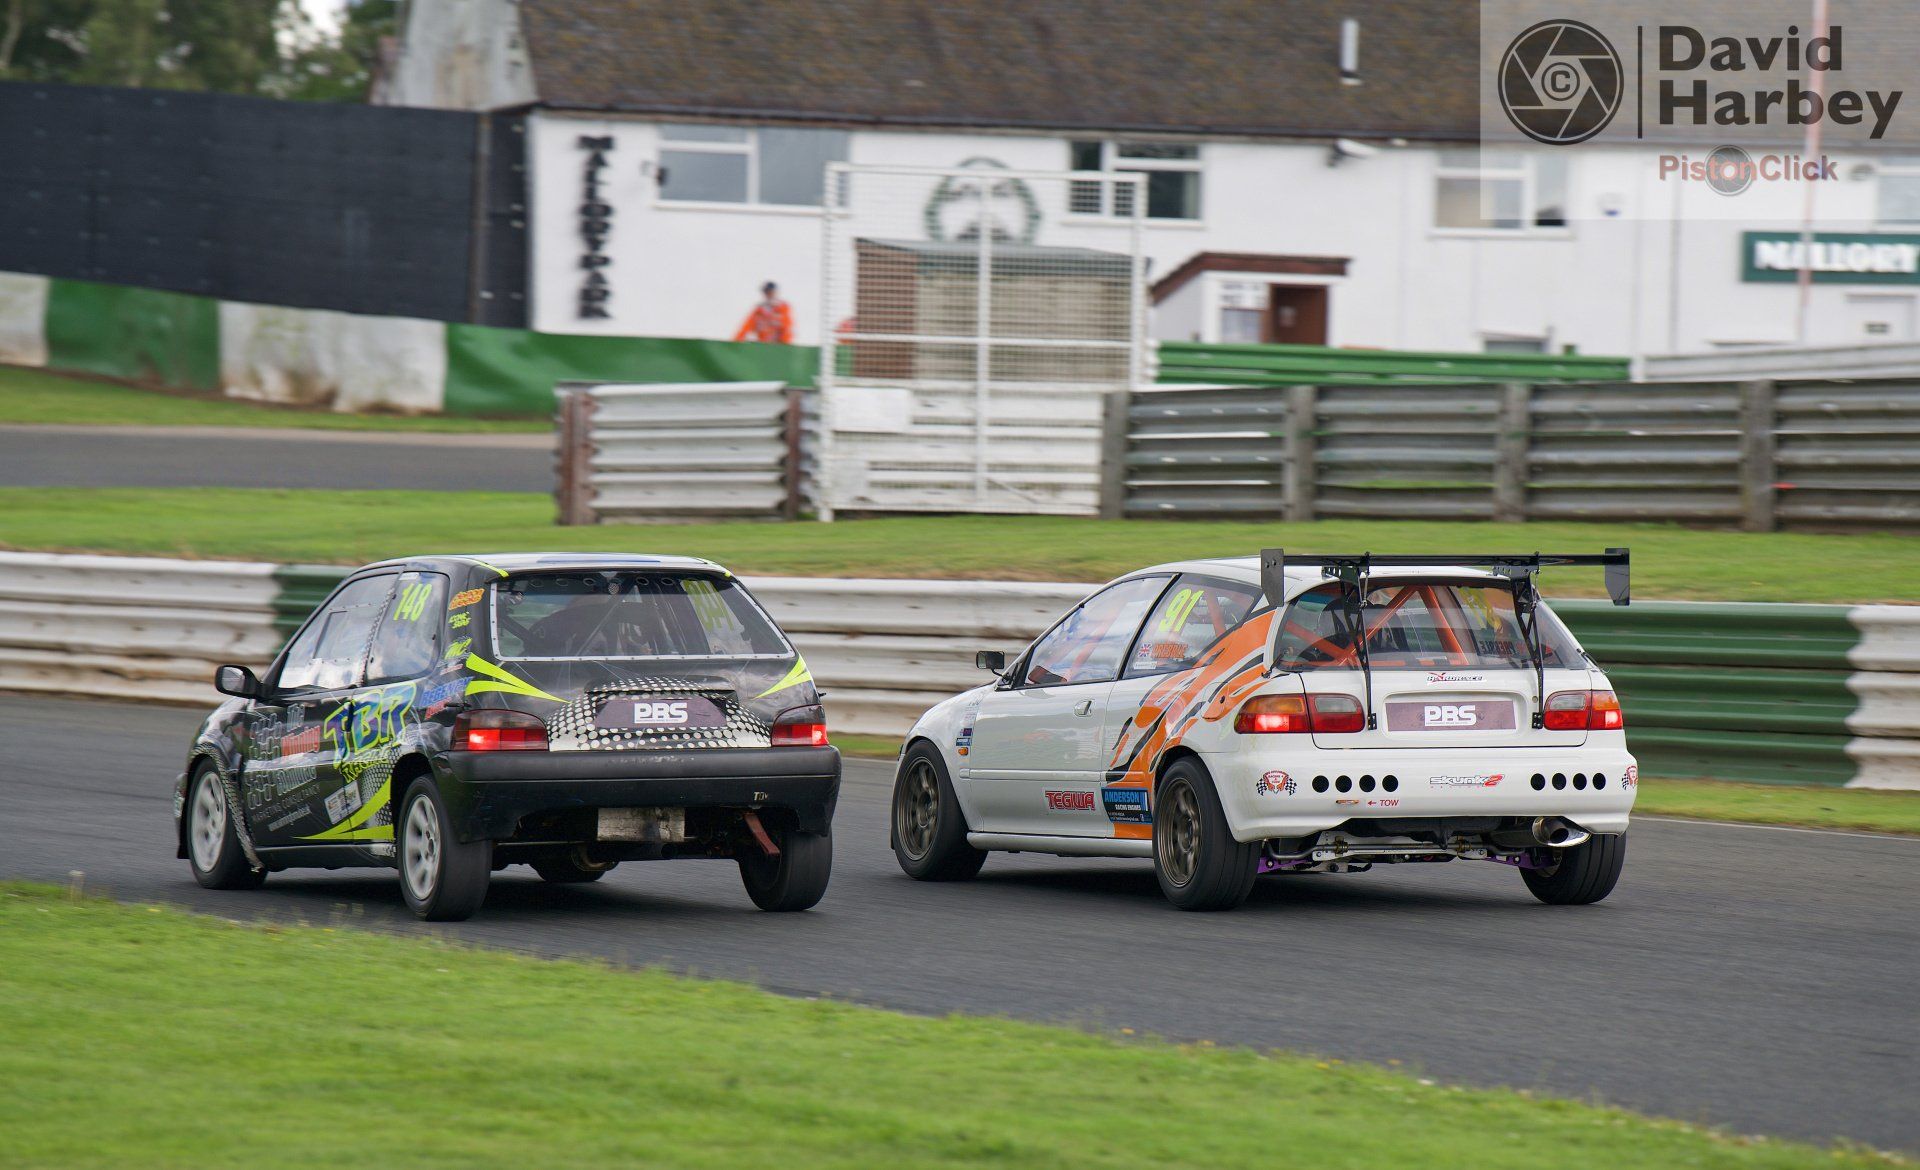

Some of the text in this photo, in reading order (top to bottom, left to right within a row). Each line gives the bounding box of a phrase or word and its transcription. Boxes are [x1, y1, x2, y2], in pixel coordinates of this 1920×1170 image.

[393, 583, 432, 621] 148
[1159, 589, 1204, 632] 91
[634, 703, 688, 723] PBS
[1425, 705, 1477, 726] PBS
[324, 682, 416, 769] TBR
[1045, 791, 1096, 811] TEGIWA
[1104, 791, 1140, 803] ANDERSON
[1379, 799, 1399, 807] TOW
